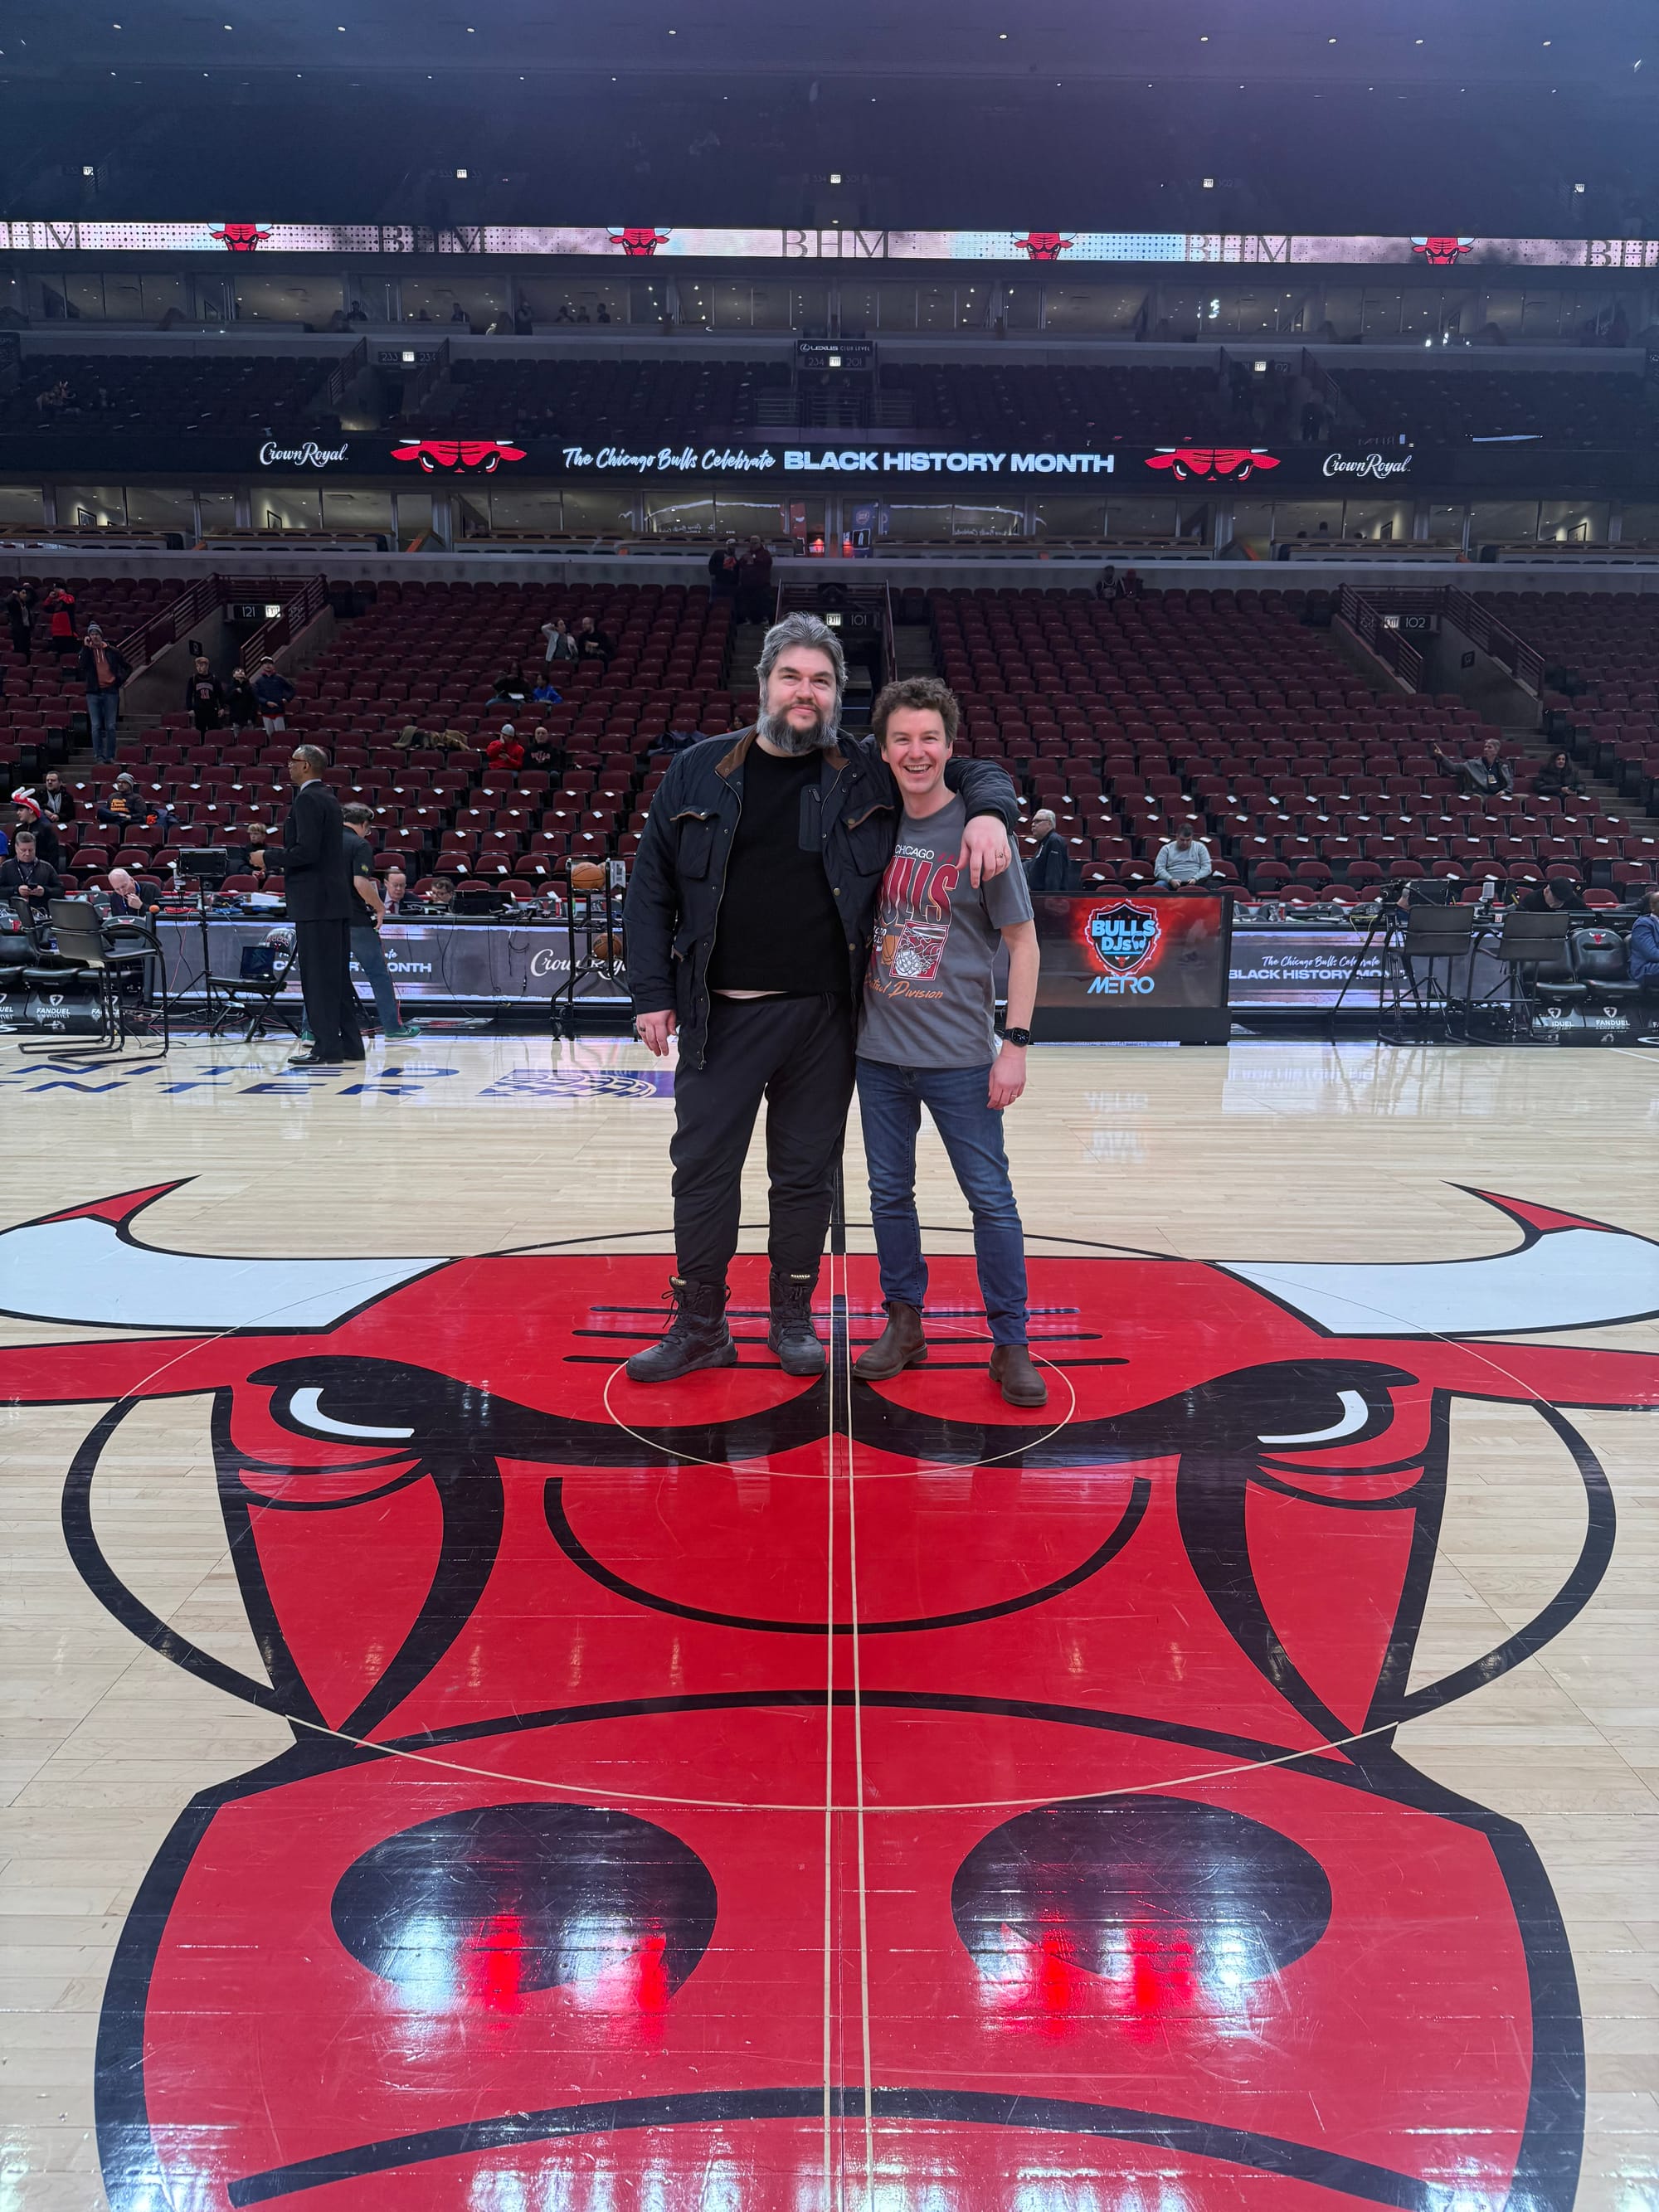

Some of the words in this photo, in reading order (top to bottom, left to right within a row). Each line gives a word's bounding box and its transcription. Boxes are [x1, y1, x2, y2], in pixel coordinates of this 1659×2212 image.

[6, 221, 80, 250] HM
[378, 226, 485, 253] BHM
[782, 230, 888, 258] BHM
[1185, 235, 1291, 263] BHM
[1585, 240, 1659, 267] BH
[260, 441, 303, 464] Crown
[294, 441, 348, 468] Royal
[562, 447, 594, 469] The
[596, 447, 656, 473] Chicago
[657, 446, 698, 471] Bulls
[701, 448, 776, 471] Celebrate
[784, 450, 878, 470] BLACK
[883, 452, 1007, 472] HISTORY
[1010, 453, 1115, 473] MONTH
[1322, 453, 1366, 477] Crown
[1357, 453, 1413, 479] Royal
[242, 605, 255, 618] 121
[851, 614, 868, 626] 101
[1406, 617, 1426, 628] 102
[894, 844, 935, 860] CHICAGO
[878, 855, 960, 926] ULLS
[1092, 920, 1156, 936] BULLS
[1101, 936, 1131, 951] DJs
[387, 962, 431, 973] ONTH
[1262, 955, 1279, 967] The
[1281, 955, 1315, 970] Chicago
[1315, 955, 1336, 968] Bulls
[1339, 955, 1381, 967] Celerate
[1228, 969, 1281, 980] BLACK
[1283, 969, 1352, 980] HISTORY
[888, 981, 944, 999] Division
[1087, 976, 1155, 994] METRO
[0, 1063, 460, 1077] NITED
